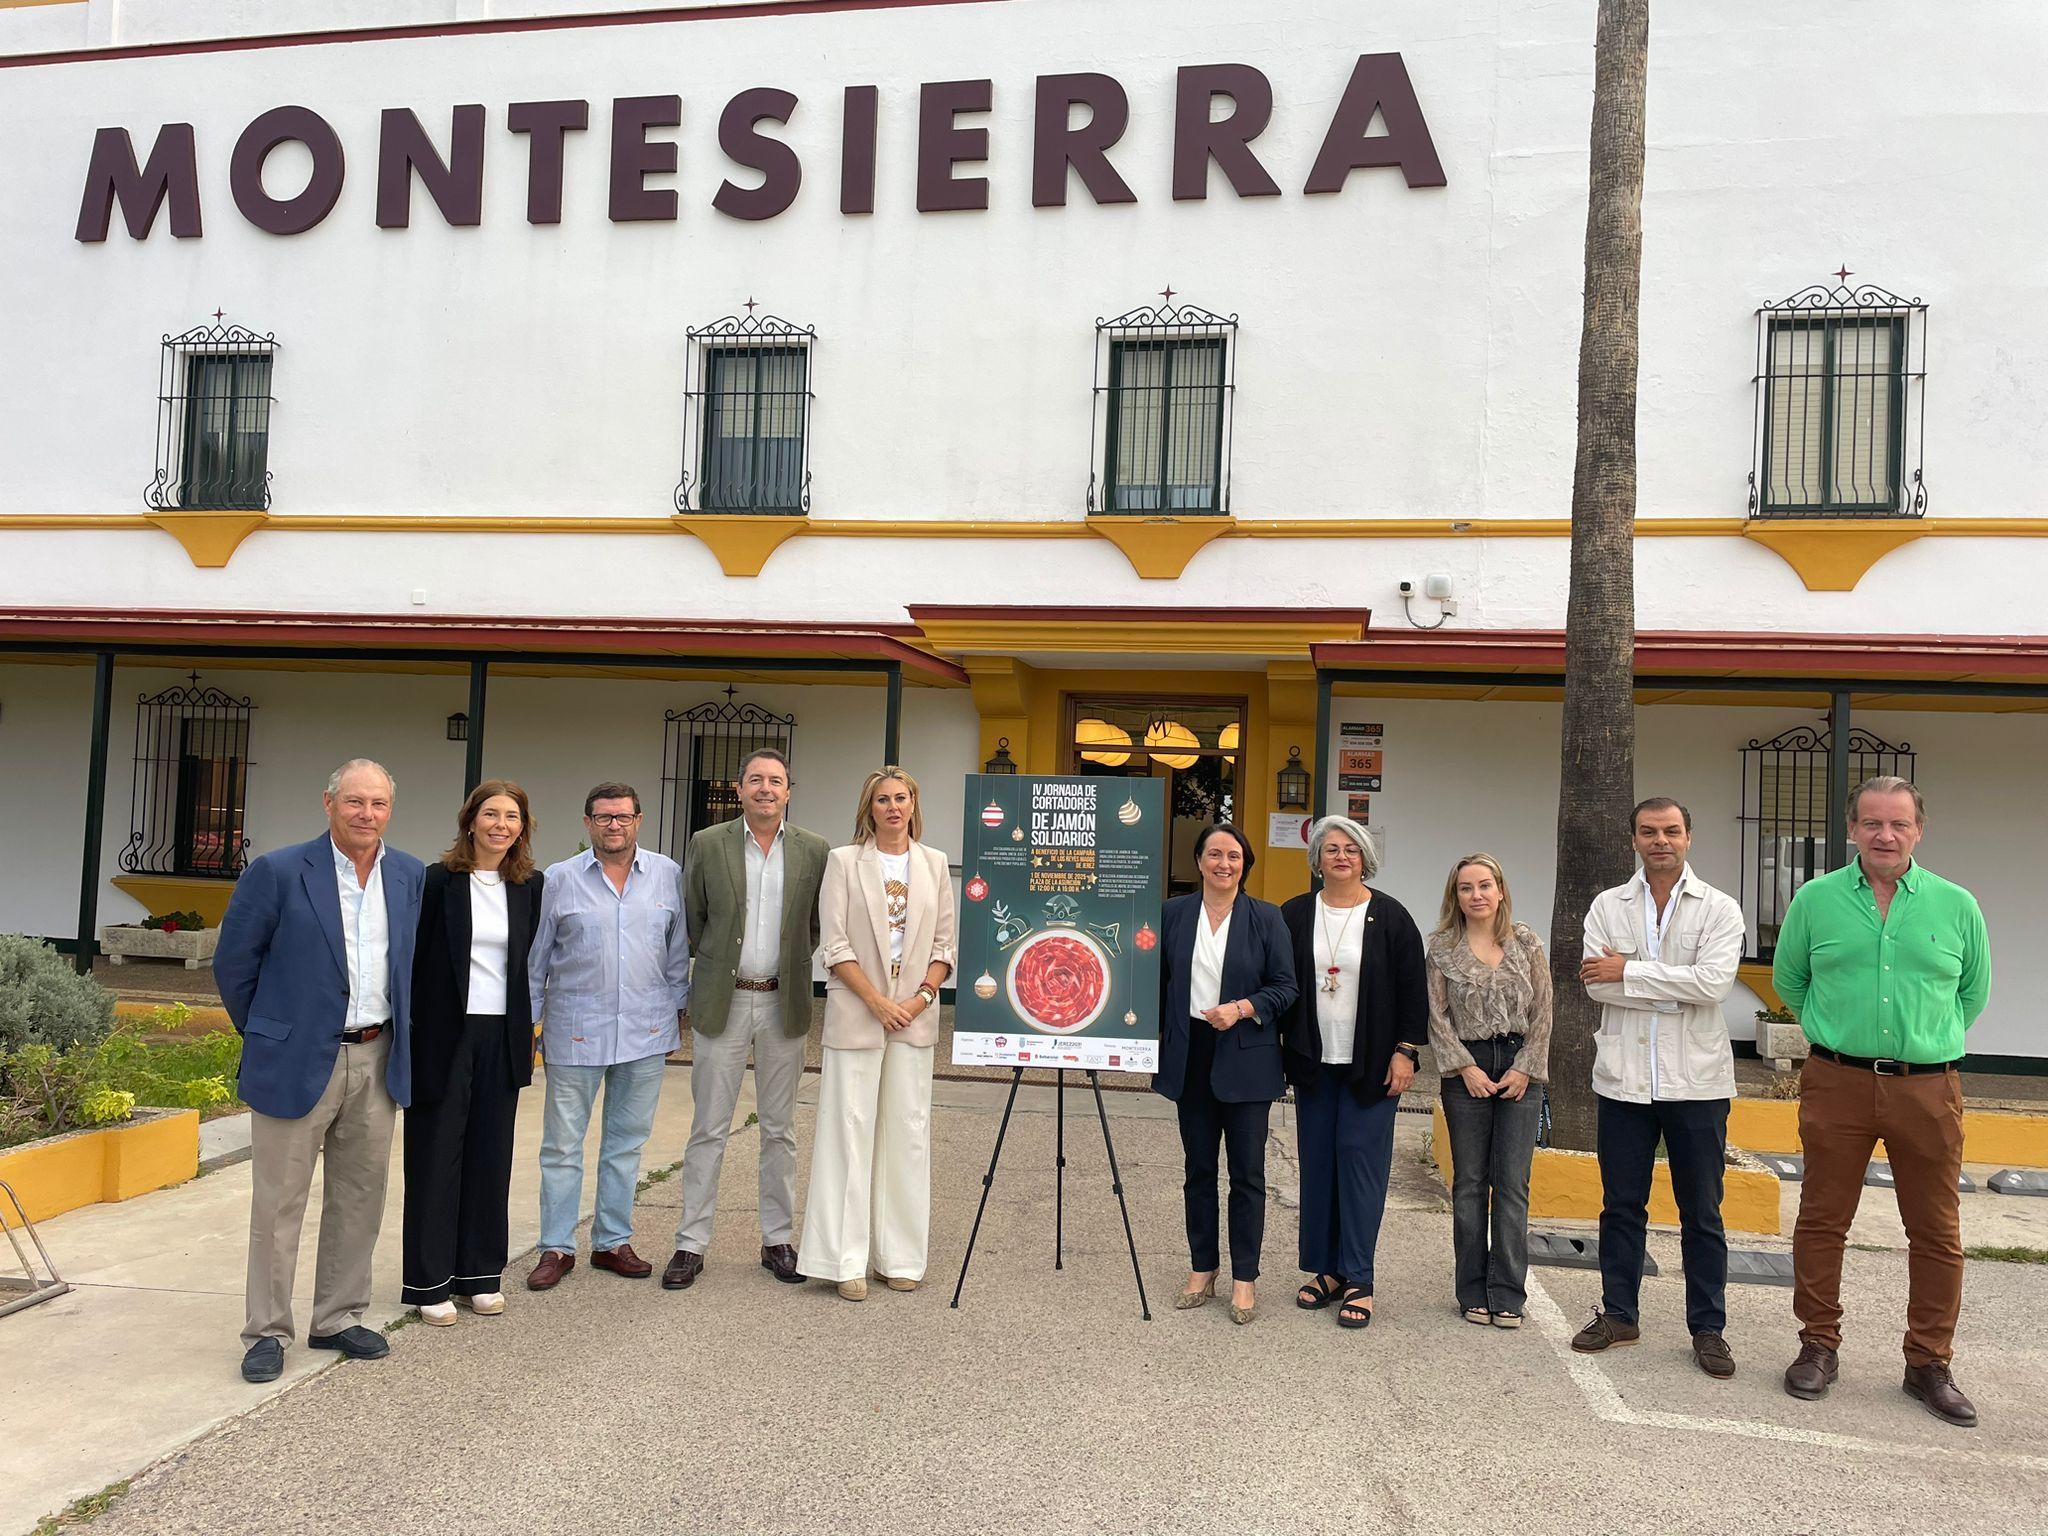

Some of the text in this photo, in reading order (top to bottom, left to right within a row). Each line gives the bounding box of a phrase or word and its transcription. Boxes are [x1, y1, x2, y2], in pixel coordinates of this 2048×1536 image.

[75, 52, 1446, 242] MONTESIERRA
[1365, 725, 1382, 733] 365
[1350, 758, 1372, 769] 365
[1032, 784, 1097, 797] IV JORNADA DE
[1032, 796, 1096, 810] CORTADORES
[1032, 811, 1096, 831] DE JAMÓN
[1031, 830, 1096, 847] SOLIDARIOS
